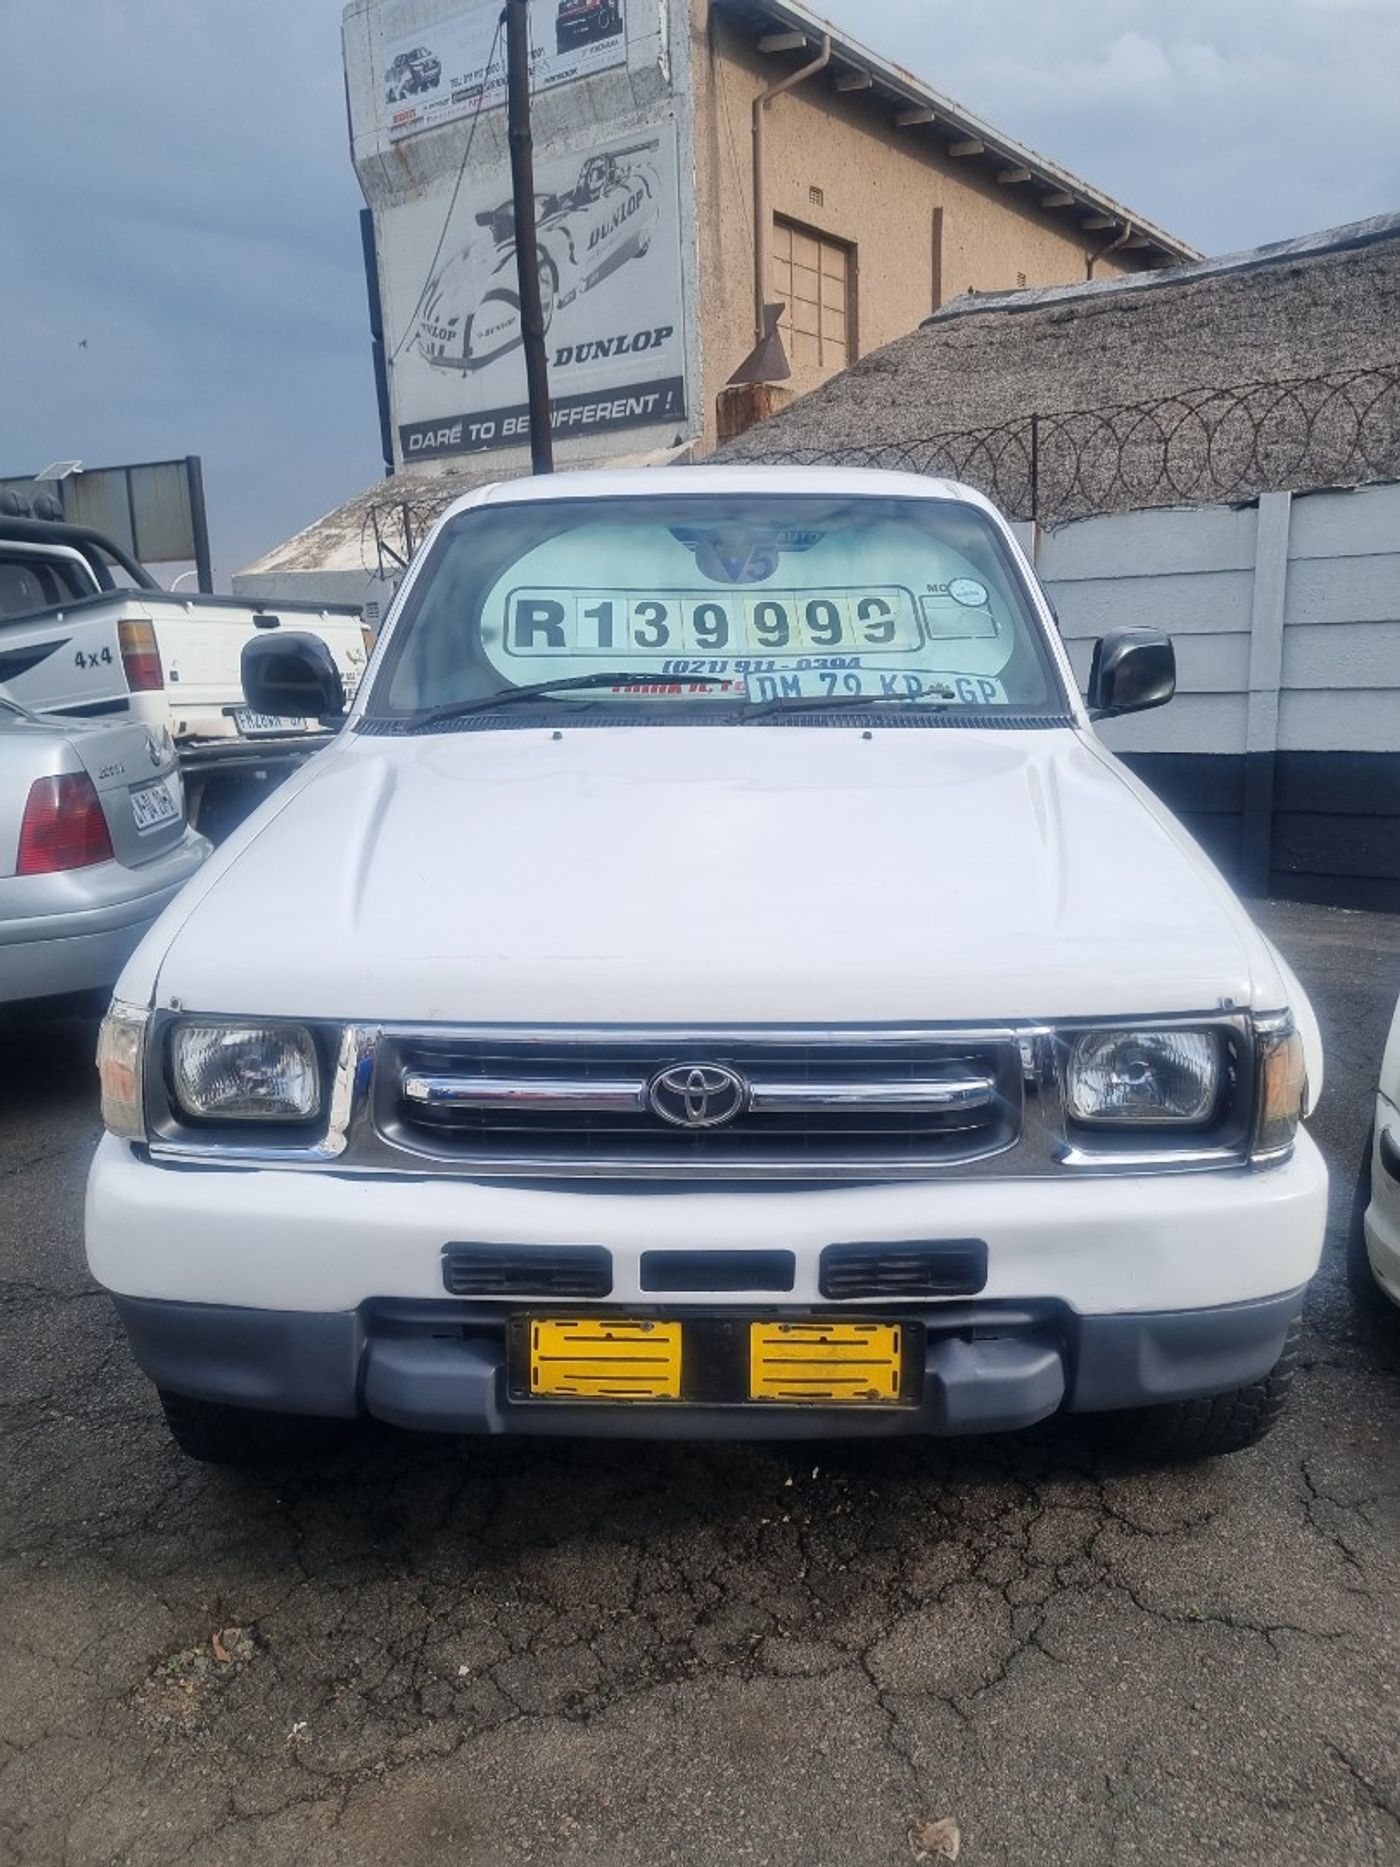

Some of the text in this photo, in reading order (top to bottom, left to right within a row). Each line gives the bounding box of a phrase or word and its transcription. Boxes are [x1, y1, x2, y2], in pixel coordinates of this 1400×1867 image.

[586, 187, 645, 252] DUNLOP
[553, 326, 674, 368] DUNLOP
[409, 427, 462, 450] DARE
[468, 421, 496, 441] TO
[502, 415, 530, 437] BE
[549, 393, 660, 429] IFFERENT
[74, 647, 113, 669] 4x4
[662, 660, 729, 674] (021)
